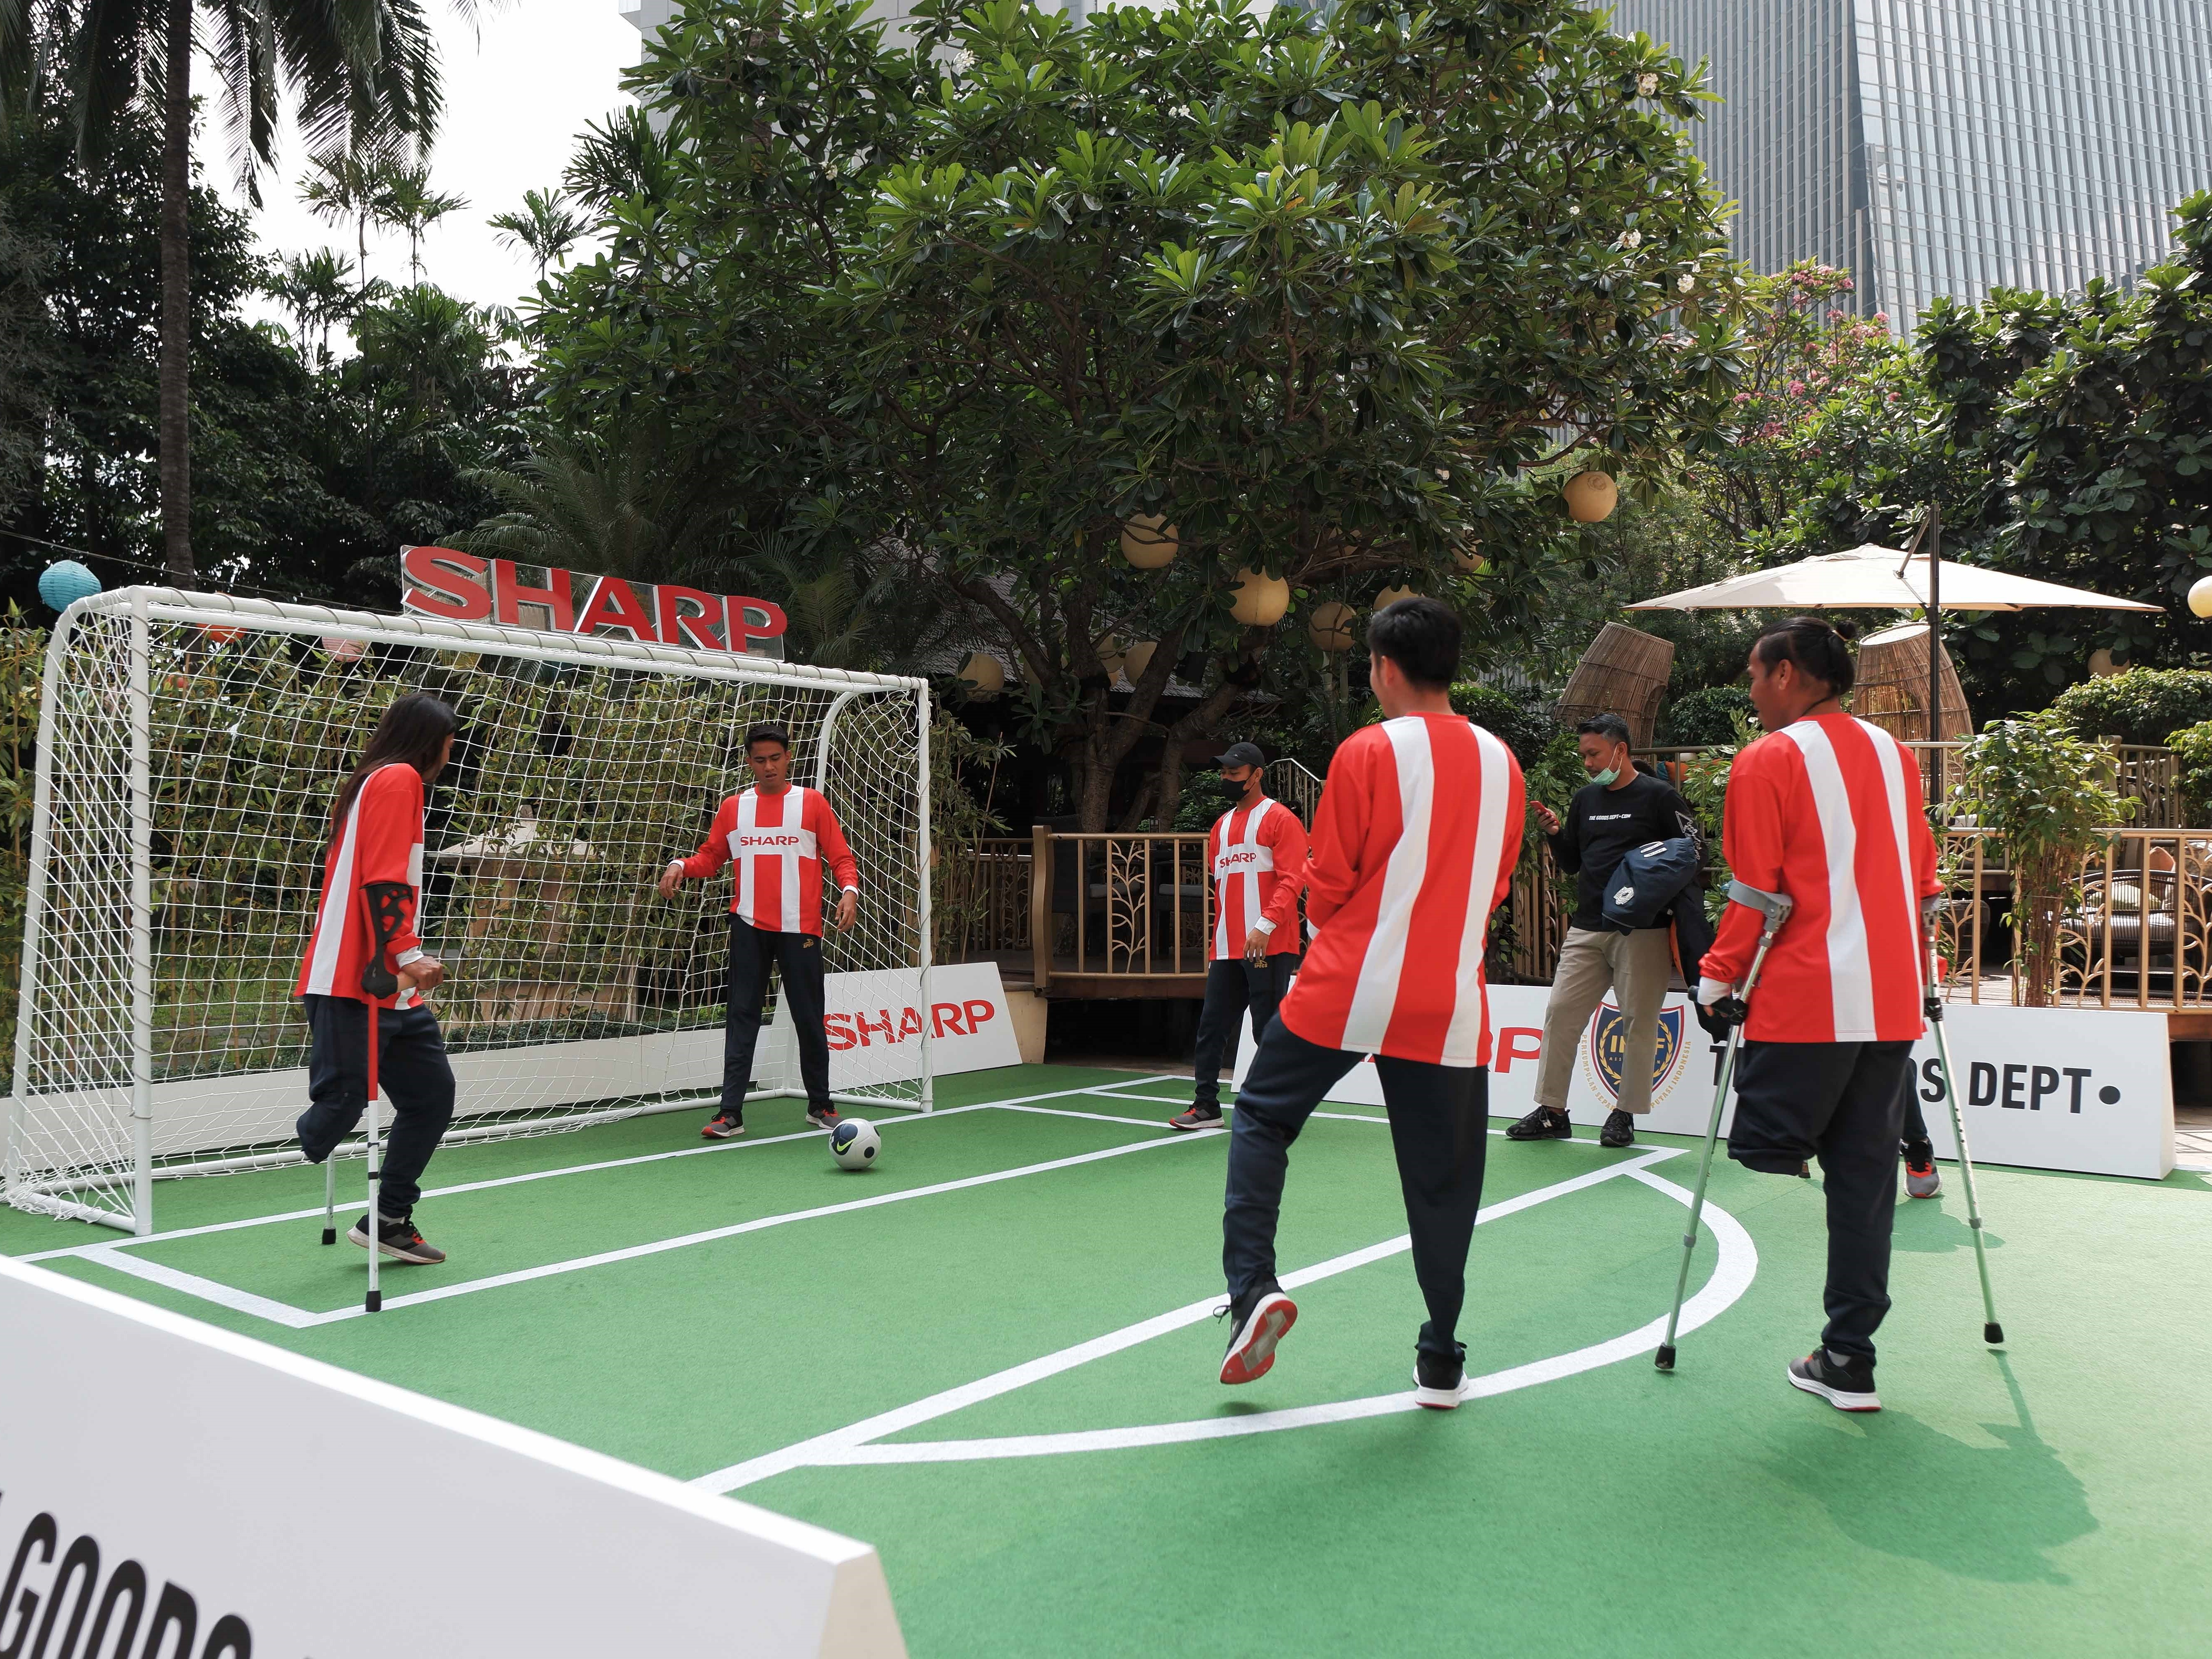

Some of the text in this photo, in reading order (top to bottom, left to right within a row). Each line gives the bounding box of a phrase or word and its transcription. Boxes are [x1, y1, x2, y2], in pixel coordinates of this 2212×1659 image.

[402, 546, 787, 652] SHARP
[741, 836, 799, 846] SHARP
[1219, 853, 1256, 868] SHARP
[823, 999, 995, 1051] SHARP
[1671, 1041, 1691, 1085] INDONESIA
